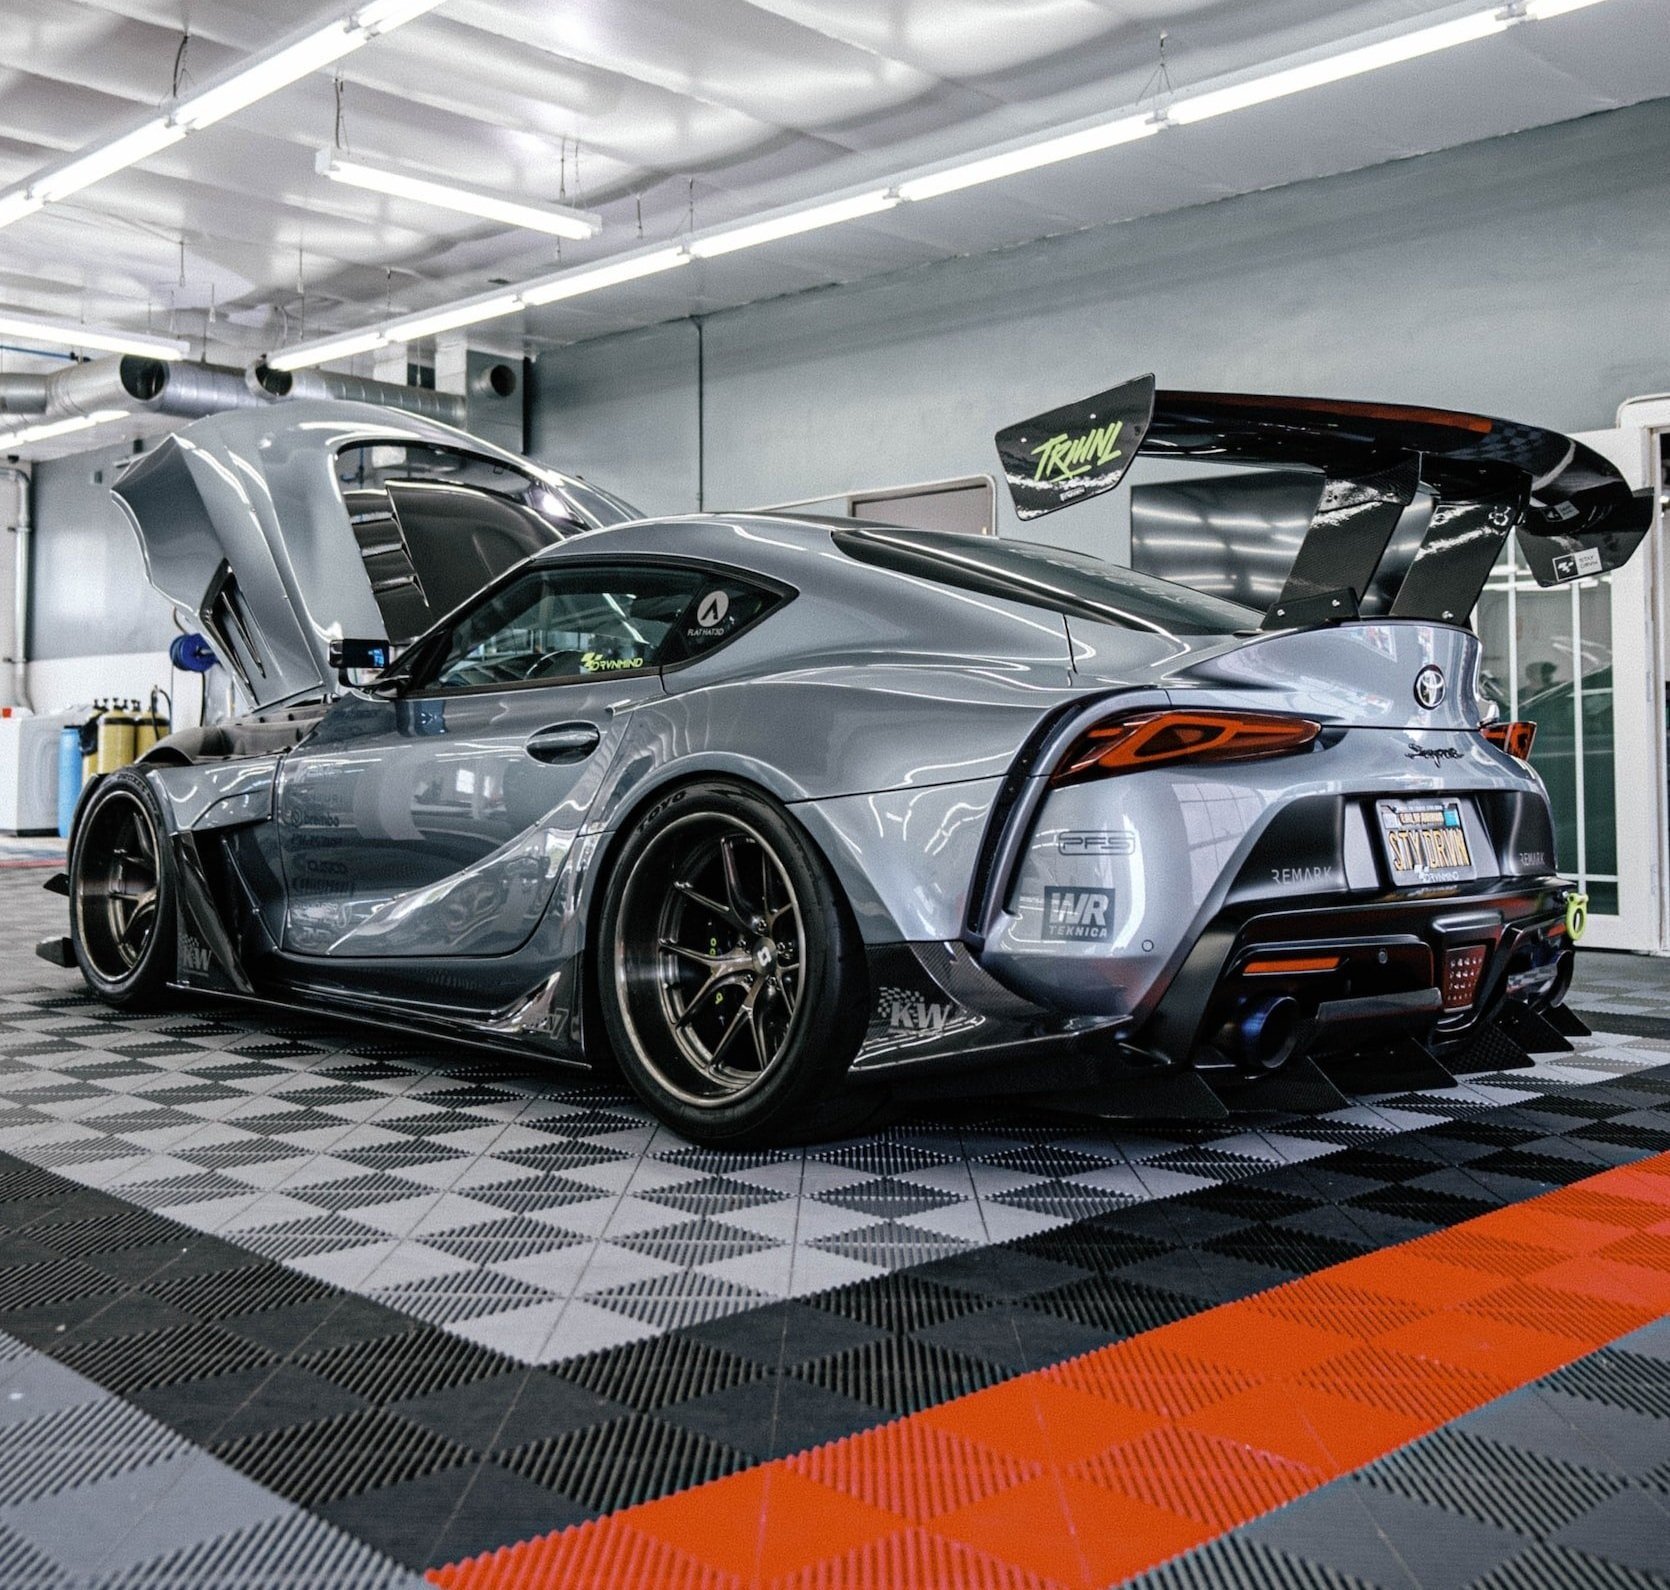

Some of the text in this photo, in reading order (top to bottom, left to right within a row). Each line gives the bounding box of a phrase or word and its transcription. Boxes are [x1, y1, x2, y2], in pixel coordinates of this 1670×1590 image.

[1271, 866, 1332, 885] REMARK
[1050, 892, 1109, 925] WR
[1049, 925, 1108, 938] TEKNICA
[890, 1001, 952, 1031] KW
